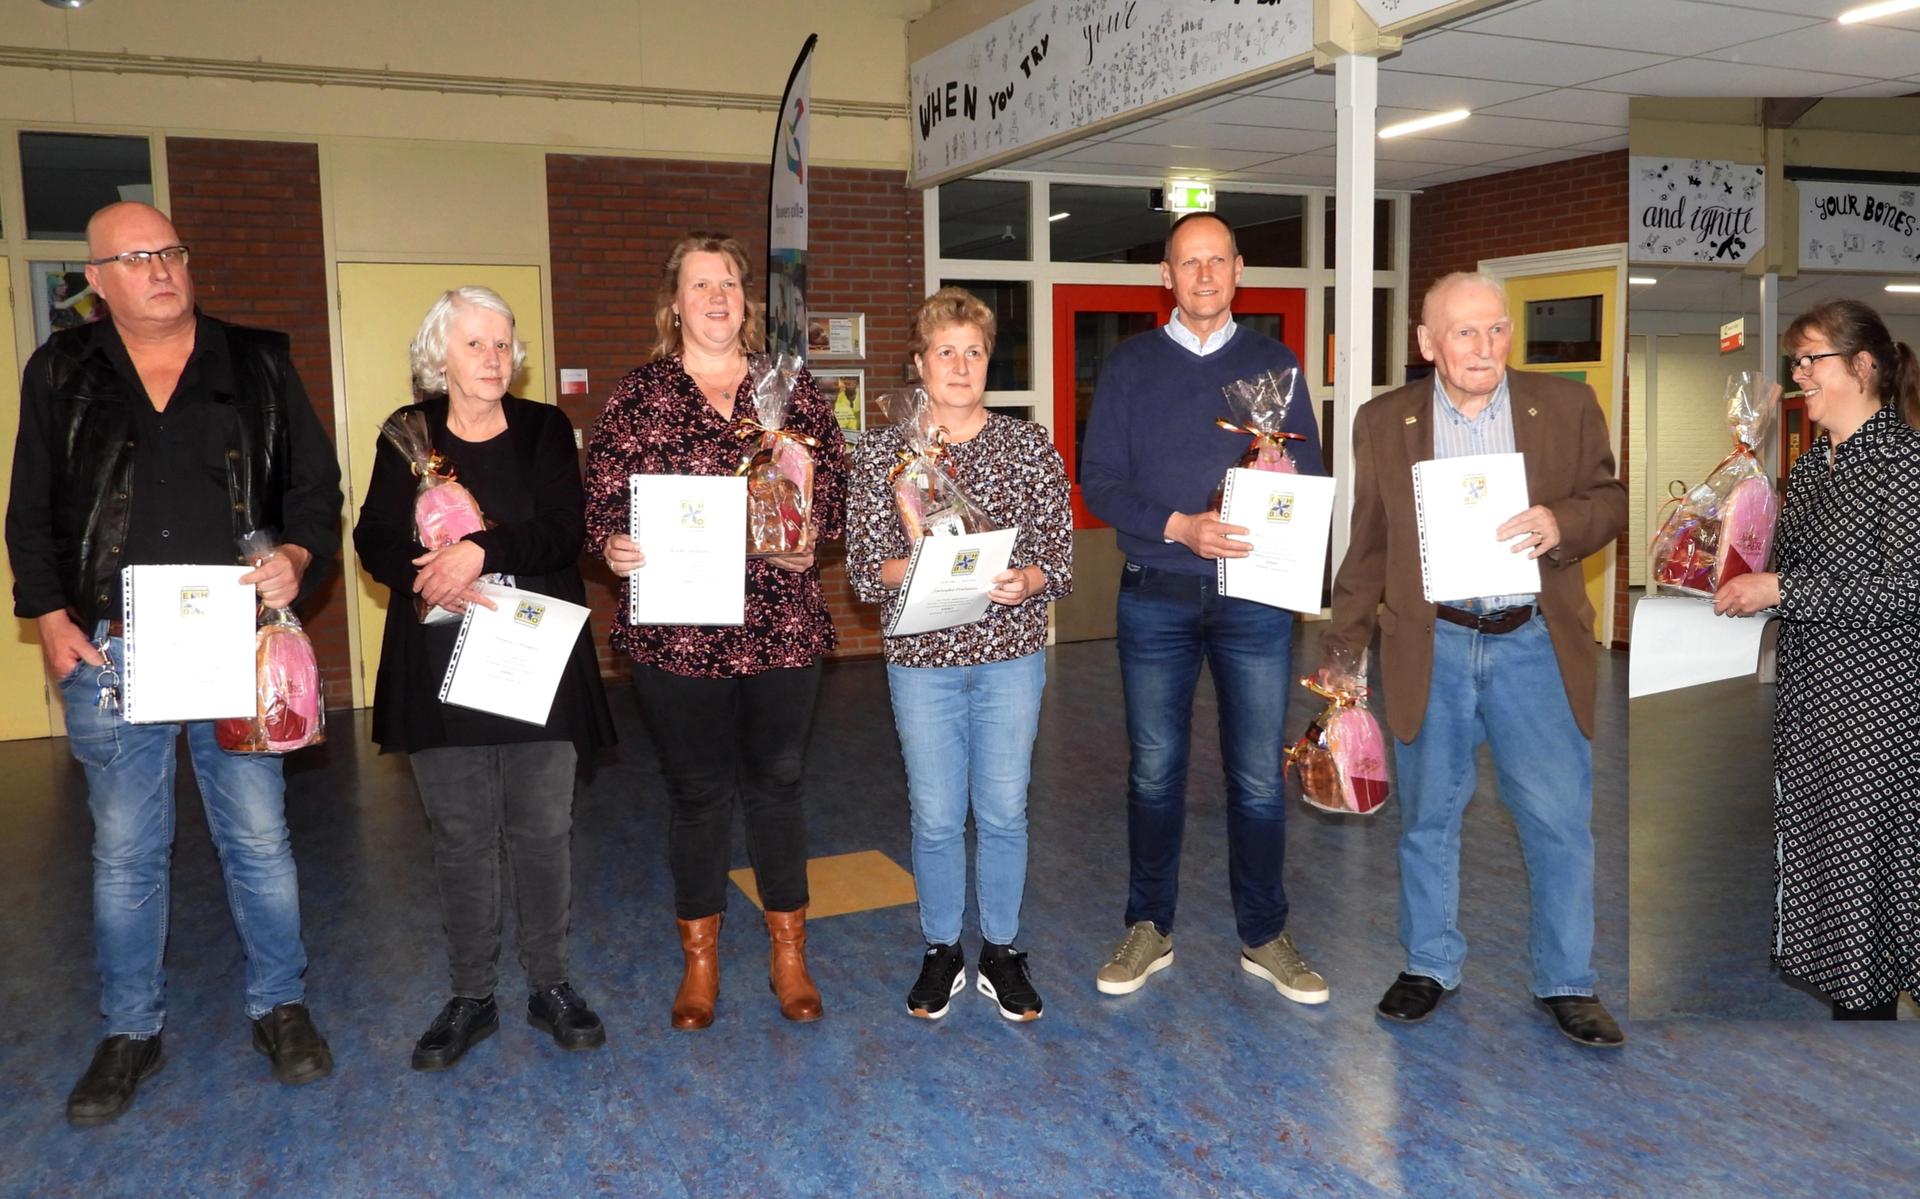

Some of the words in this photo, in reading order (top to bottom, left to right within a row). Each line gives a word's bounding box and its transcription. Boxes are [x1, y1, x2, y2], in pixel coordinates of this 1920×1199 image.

[919, 80, 978, 142] WHEN
[989, 82, 1015, 120] YOU
[1020, 33, 1049, 80] TRY
[1643, 196, 1687, 229] and
[1691, 205, 1758, 244] ignite
[1815, 193, 1861, 220] YOUR
